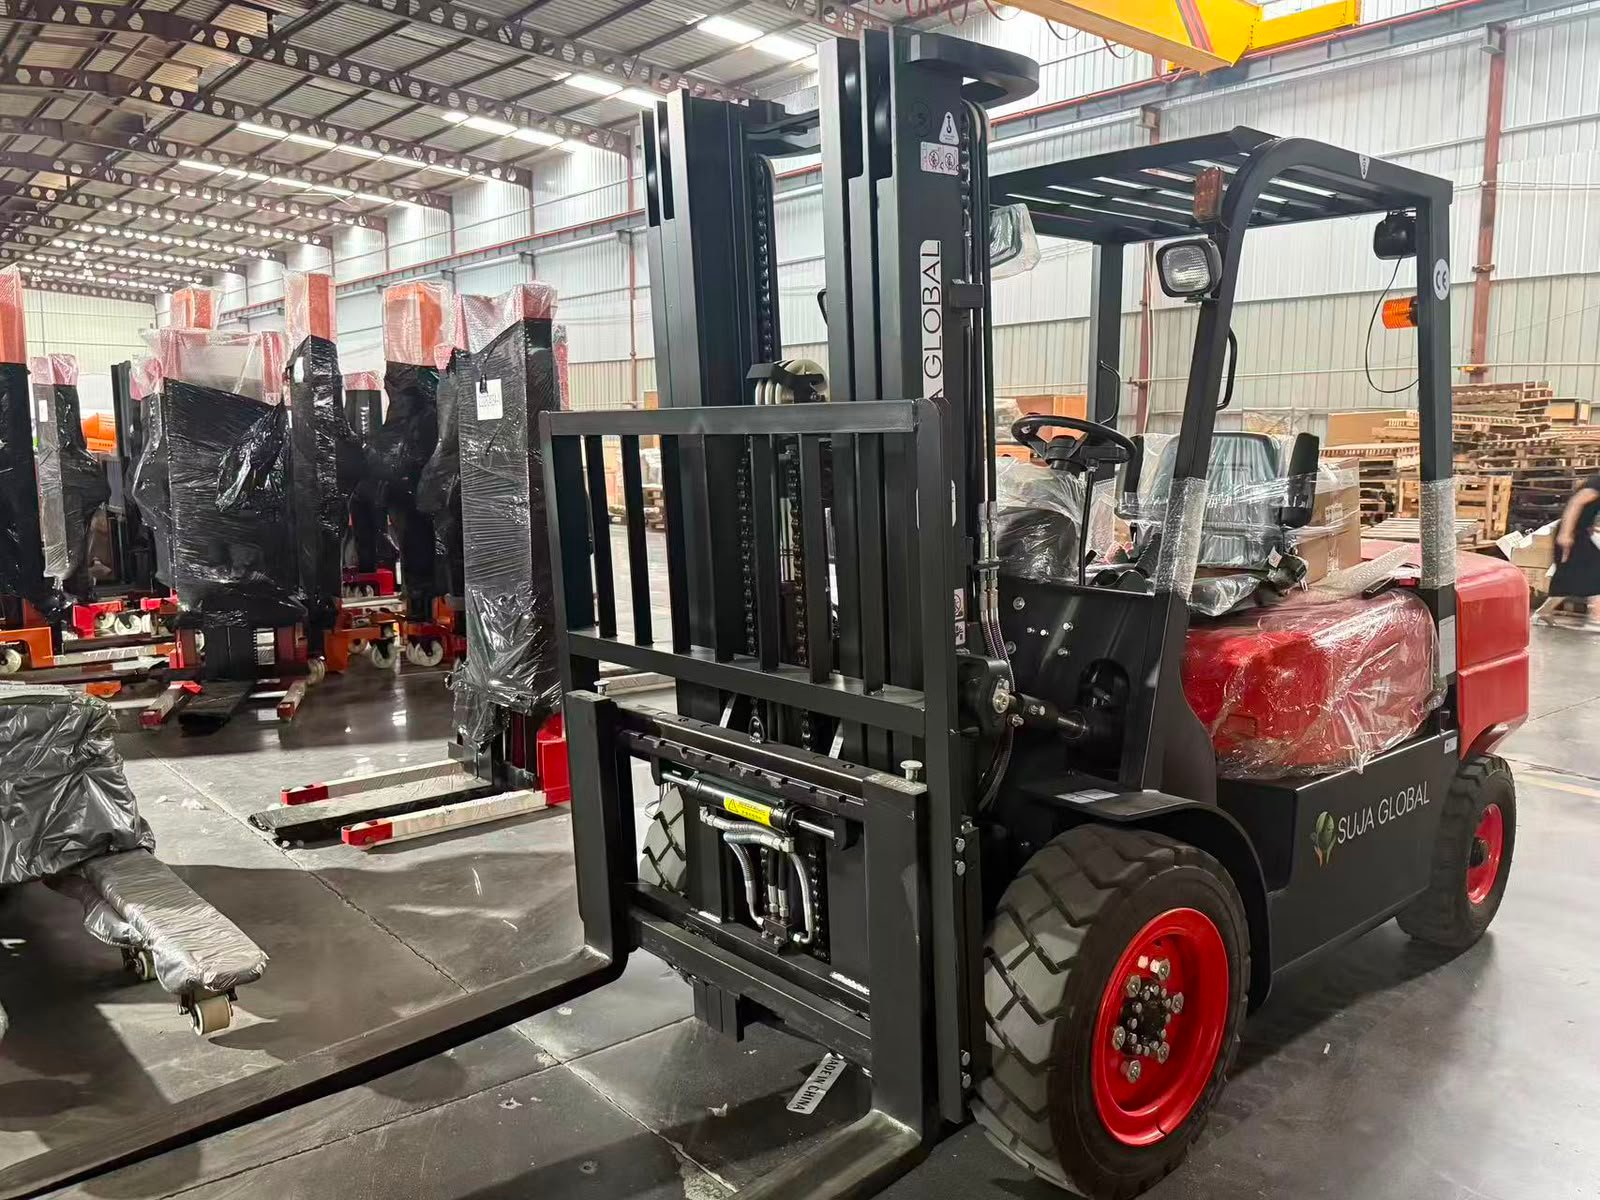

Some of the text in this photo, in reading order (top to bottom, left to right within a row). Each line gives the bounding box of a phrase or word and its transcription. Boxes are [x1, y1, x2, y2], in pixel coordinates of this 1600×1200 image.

[1436, 270, 1447, 291] CE
[922, 241, 942, 379] GLOBAL
[1337, 781, 1430, 844] SUJA GLOBAL
[816, 1075, 826, 1085] IN
[793, 1085, 820, 1111] CHINA
